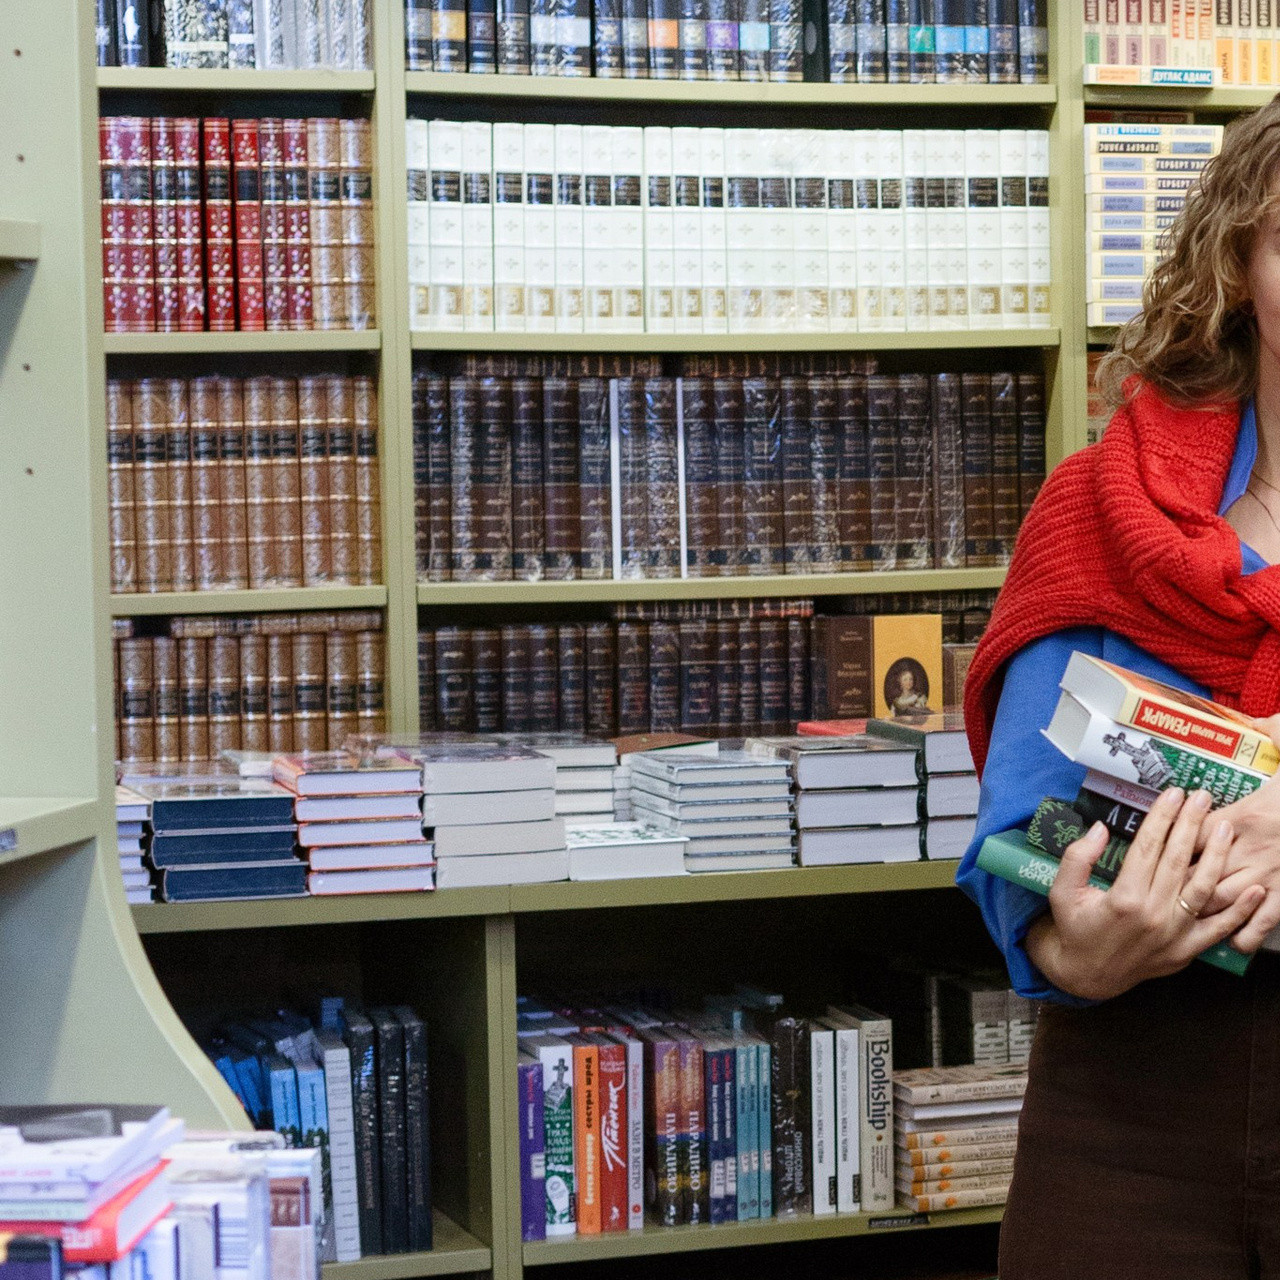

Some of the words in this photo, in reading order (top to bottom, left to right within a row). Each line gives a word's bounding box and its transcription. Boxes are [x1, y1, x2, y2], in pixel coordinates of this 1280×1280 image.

[1240, 0, 1250, 26] ФРЭНК
[1258, 0, 1269, 27] ФРЭНК
[1152, 70, 1183, 83] ДУГЛАС
[1183, 71, 1212, 84] АДАМС
[1140, 705, 1192, 737] РЕМАРК
[1201, 767, 1217, 791] ЯЗЬ
[869, 1038, 890, 1131] Bookship
[631, 1120, 641, 1146] ЗАЗИ
[665, 1112, 678, 1193] ПАРАДИЗО
[688, 1110, 699, 1191] ПАРАДИЗО
[786, 1144, 794, 1180] ШТОРМ
[793, 1130, 804, 1194] ОНИКСОВЫЙ
[631, 1156, 641, 1191] МЕТРО
